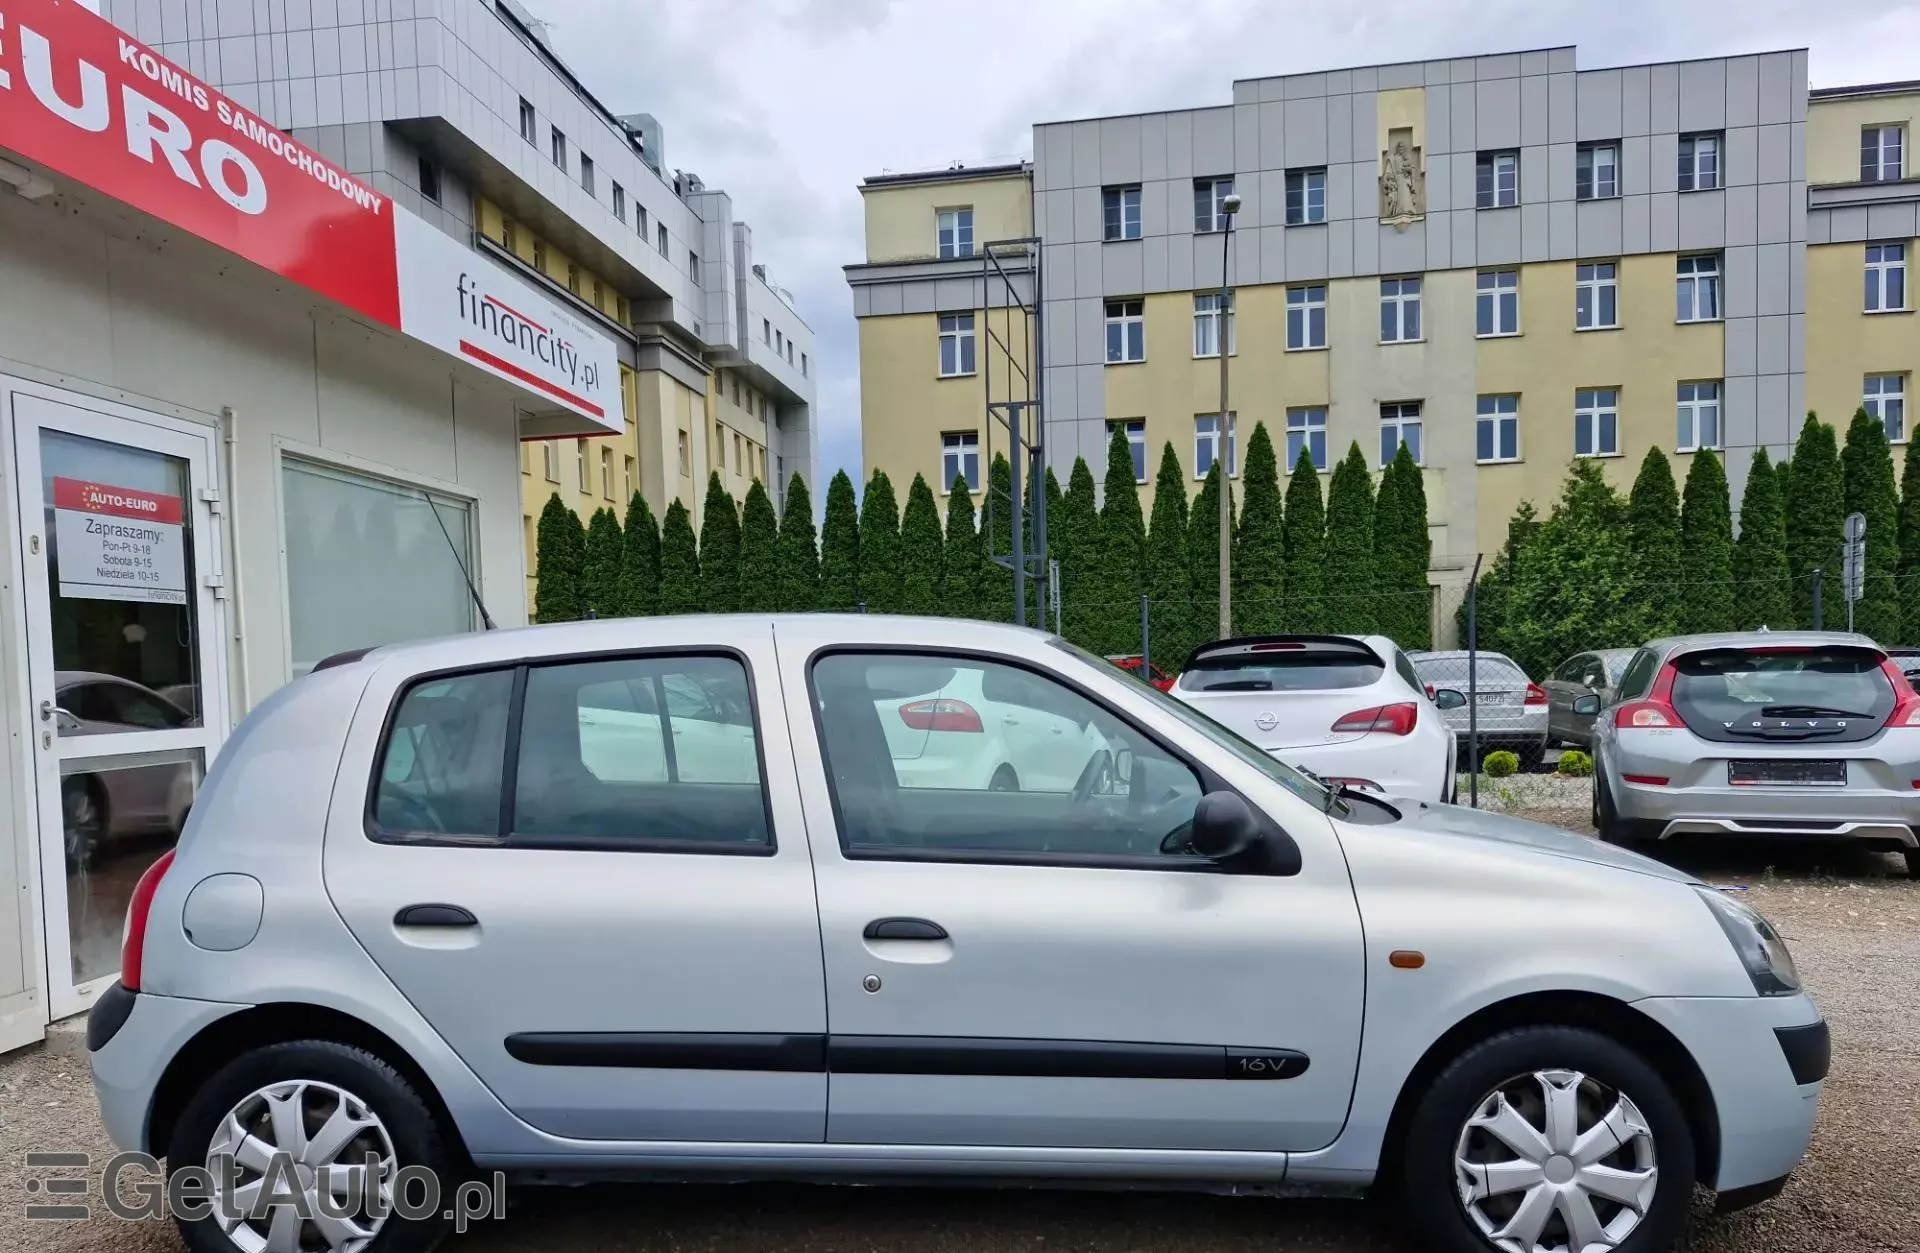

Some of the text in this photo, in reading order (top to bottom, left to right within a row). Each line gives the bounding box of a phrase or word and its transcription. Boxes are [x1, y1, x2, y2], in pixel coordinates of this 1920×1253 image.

[0, 12, 268, 216] URO
[118, 36, 383, 215] KOMIS SAMOCHODOWY
[456, 272, 600, 392] financity.pl
[90, 491, 158, 512] AUTO-EURO
[85, 518, 165, 545] Zapraszamy:
[132, 543, 151, 555] 9-18
[103, 554, 153, 569] Sobota 9-15
[96, 567, 160, 582] Niedziela 10-15
[1722, 720, 1847, 729] VOLVO
[1239, 1058, 1287, 1073] 16V
